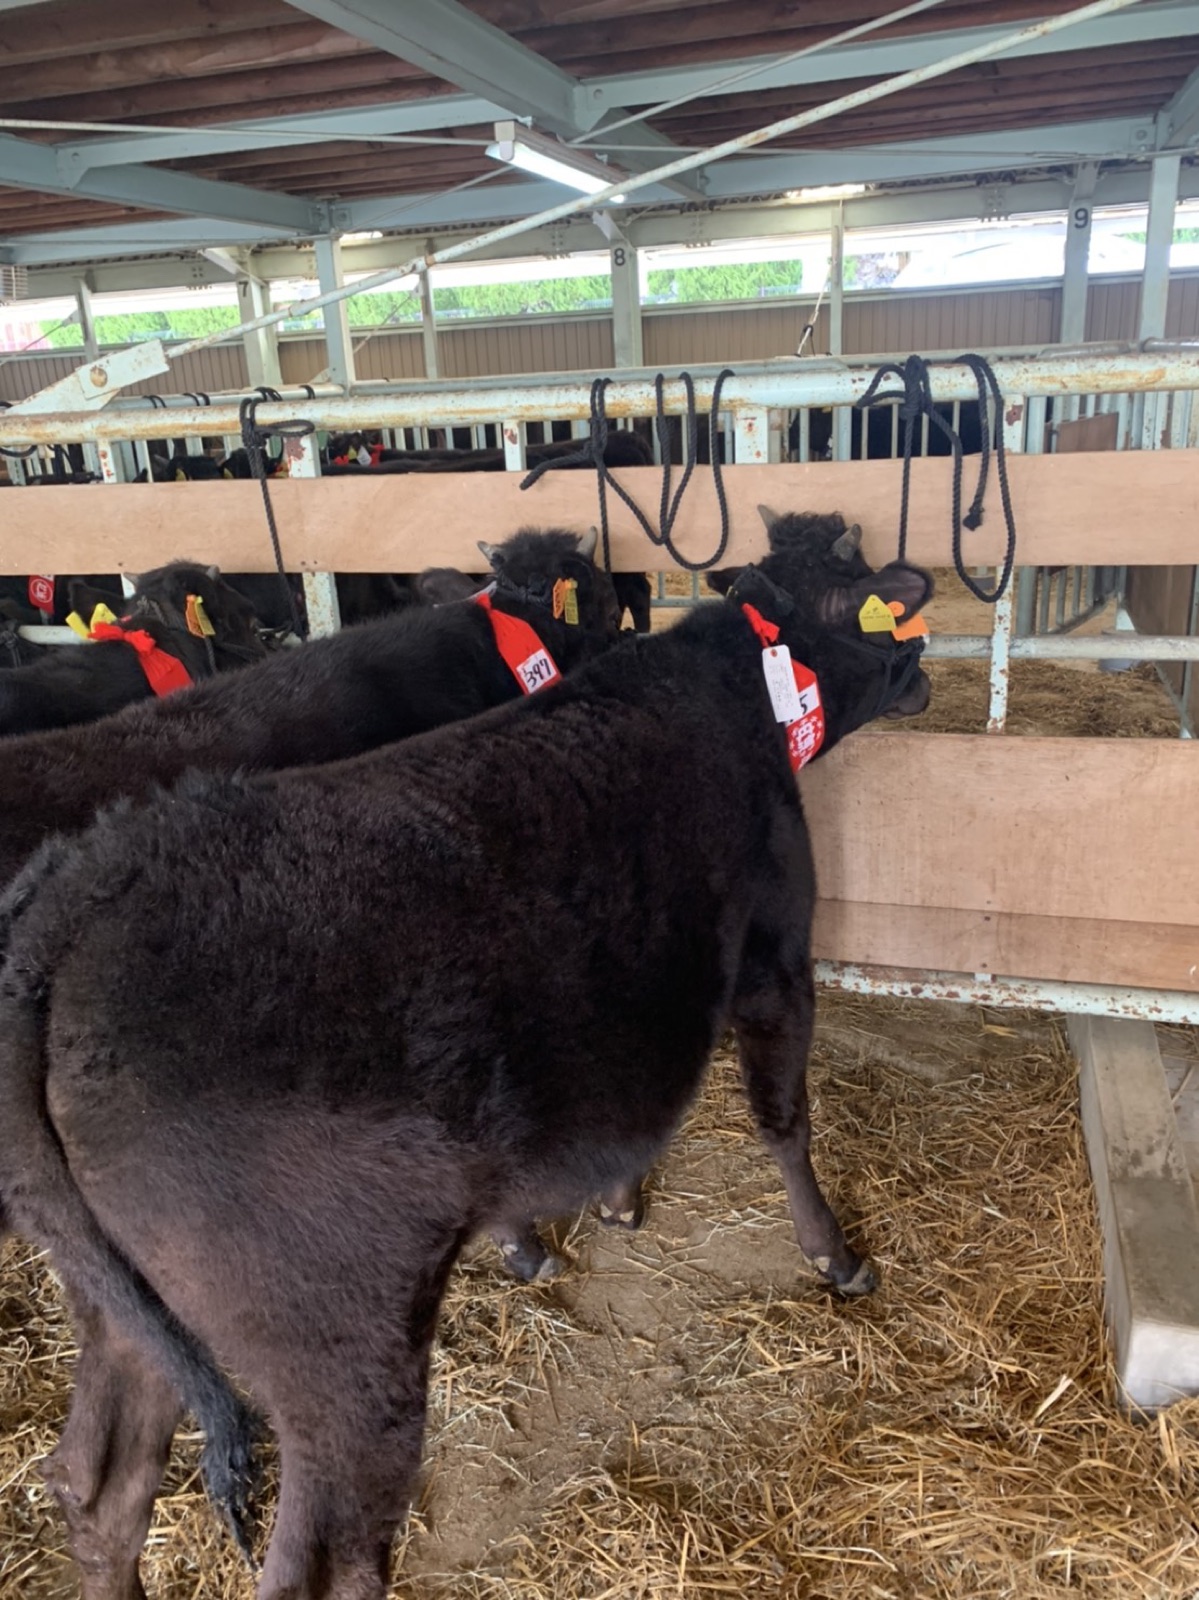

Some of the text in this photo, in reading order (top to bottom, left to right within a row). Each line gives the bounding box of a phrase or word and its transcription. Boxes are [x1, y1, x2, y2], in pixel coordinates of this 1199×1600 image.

[1074, 207, 1089, 229] 9
[614, 247, 625, 267] 8
[238, 281, 249, 298] 7
